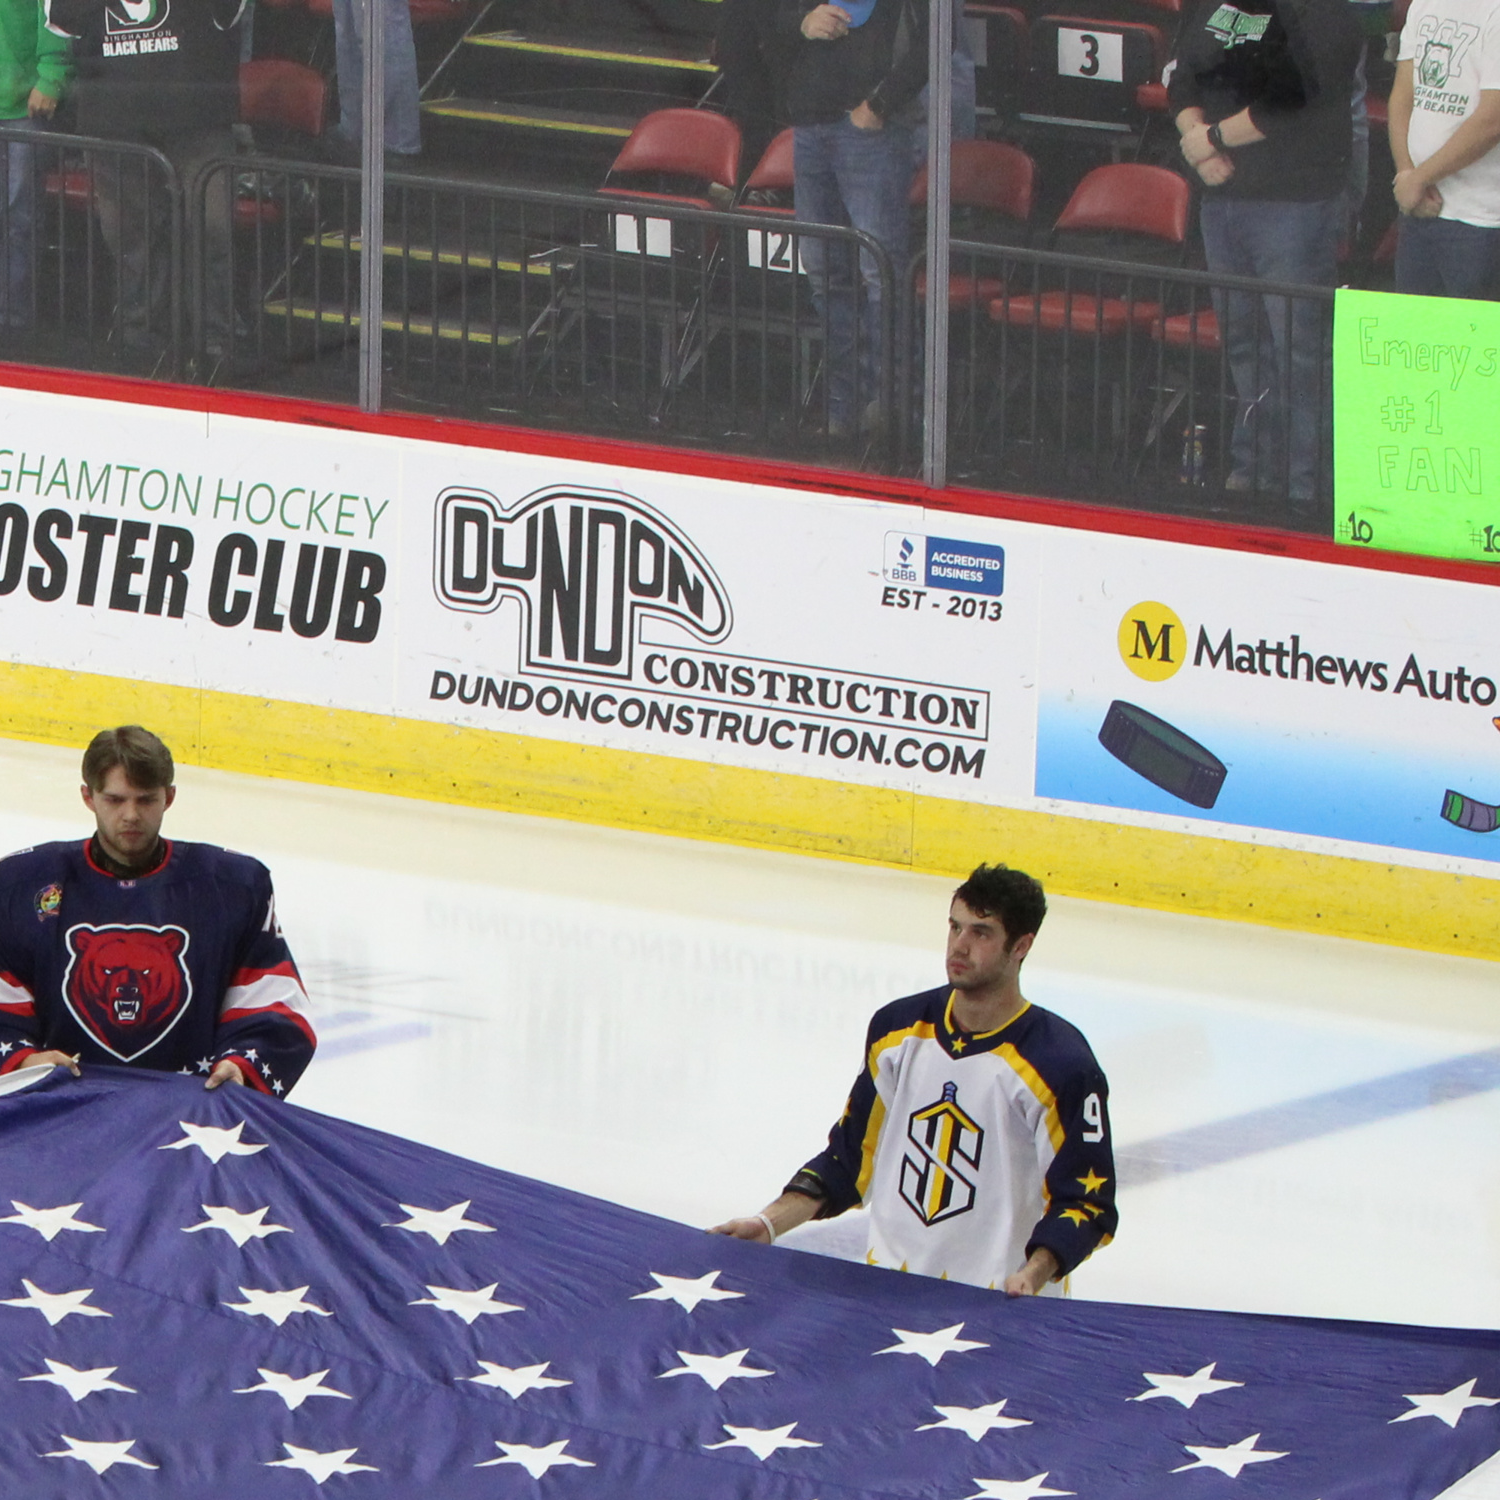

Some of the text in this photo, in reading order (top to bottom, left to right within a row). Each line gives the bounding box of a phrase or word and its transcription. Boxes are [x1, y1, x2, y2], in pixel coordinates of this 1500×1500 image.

[102, 36, 179, 57] BLACK BEARS
[104, 30, 172, 42] BINGHAMTON
[1080, 34, 1100, 76] 3
[1424, 101, 1466, 116] BEARS
[769, 232, 792, 268] 2
[1359, 317, 1498, 391] Emery's
[1377, 446, 1482, 495] FAN
[212, 478, 389, 541] HOCKEY
[1338, 511, 1373, 543] #10
[453, 505, 703, 668] DUNDON
[892, 552, 1000, 581] BBB ACCREDITED
[931, 565, 984, 582] BUSINESS
[208, 533, 388, 645] CLUB
[881, 586, 927, 611] EST
[946, 595, 1003, 621] 2013
[1129, 619, 1498, 706] M Matthews Auto
[645, 652, 980, 730] CONSTRUCTION
[430, 670, 988, 778] DUNDONCONSTRUCTION.COM
